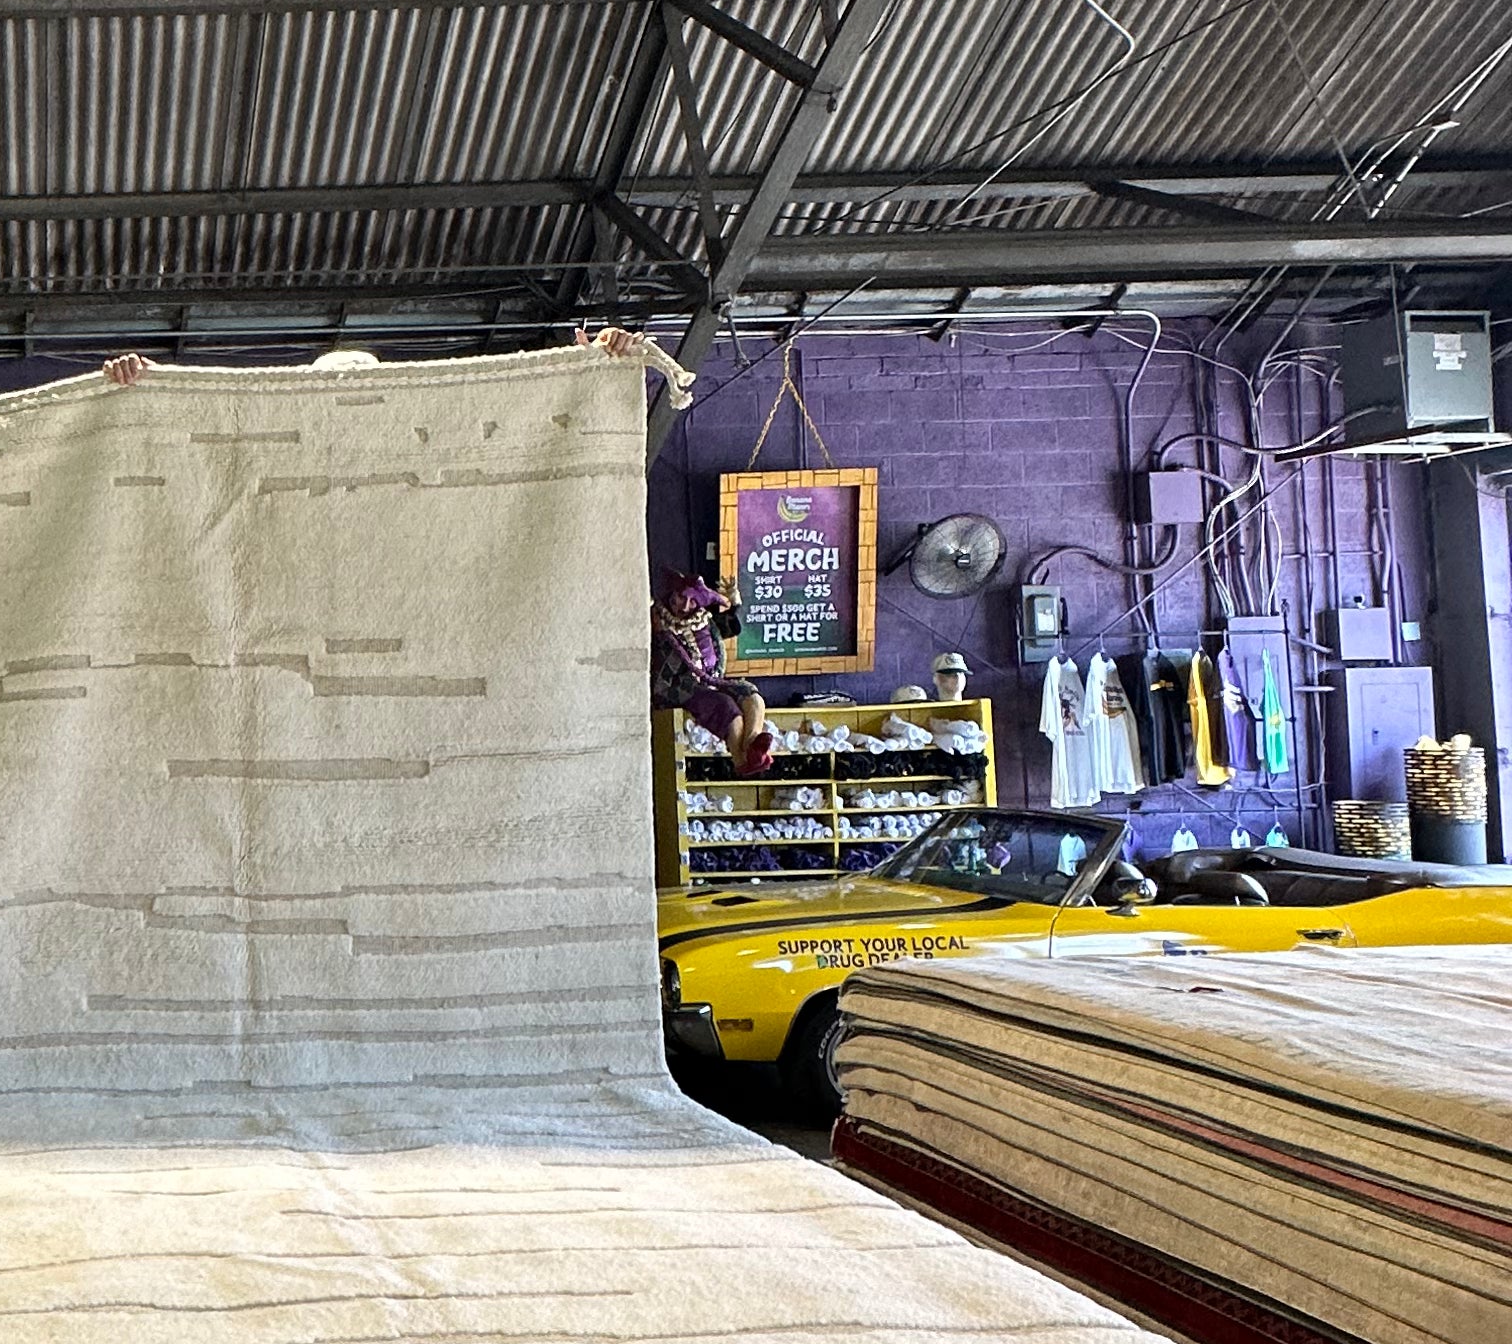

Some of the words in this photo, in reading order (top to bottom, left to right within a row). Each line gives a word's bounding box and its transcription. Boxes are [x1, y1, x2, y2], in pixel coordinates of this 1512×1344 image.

[762, 529, 825, 547] OFFICIAL
[747, 548, 839, 573] MERCH
[754, 576, 782, 585] SHIRT
[808, 574, 827, 583] HAT
[754, 585, 783, 600] $30
[804, 584, 832, 598] $35
[750, 605, 780, 614] SPEND
[806, 603, 826, 612] GET
[828, 603, 835, 611] A
[746, 614, 773, 623] SHIRT
[775, 613, 788, 622] OR
[790, 613, 798, 621] A
[799, 613, 818, 621] HAT
[819, 612, 838, 620] FOR
[763, 622, 821, 643] FREE
[778, 939, 856, 955] SUPPORT
[860, 938, 908, 953] YOUR
[911, 936, 970, 951] LOCAL
[816, 953, 864, 969] DRUG
